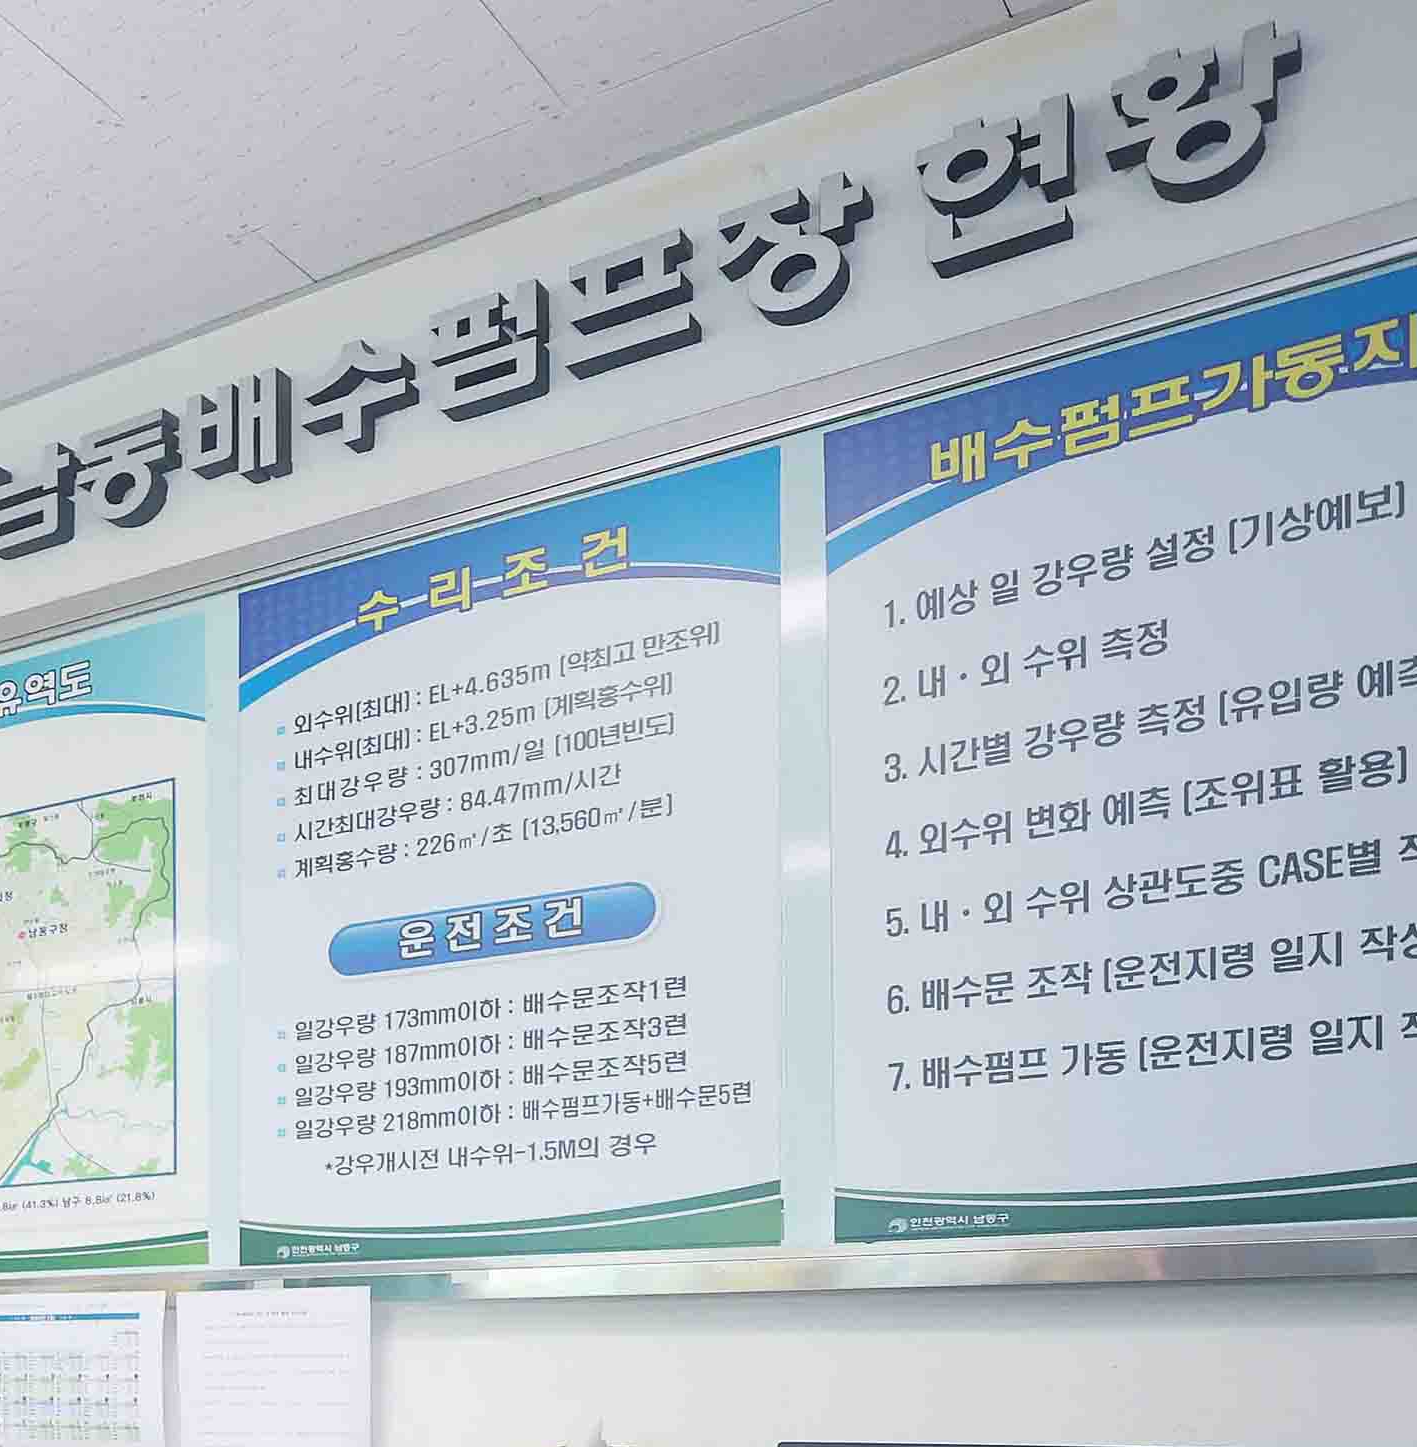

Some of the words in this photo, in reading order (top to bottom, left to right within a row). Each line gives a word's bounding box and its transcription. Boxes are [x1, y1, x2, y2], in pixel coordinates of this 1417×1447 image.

[915, 20, 1303, 278] 현황
[883, 598, 907, 629] 1.
[915, 579, 979, 622] 예상
[989, 569, 1020, 606] 일
[1032, 543, 1134, 598] 강우량
[1146, 523, 1216, 572] 설정
[428, 660, 551, 706] EL+4.635m
[882, 674, 907, 707] 2.
[1022, 634, 1088, 679] 수위
[1100, 617, 1170, 659] 측정
[428, 701, 537, 743] EL+3.25m
[883, 751, 909, 784] 3.
[917, 730, 1013, 779] 시간별
[1025, 709, 1126, 759] 강우량
[1137, 693, 1207, 738] 측정
[292, 765, 410, 807] 최대강우량
[428, 738, 546, 781] 307mm/일
[292, 796, 442, 845] 시간최대강우량
[458, 762, 623, 813] 84.47mm/시간
[884, 830, 909, 859] 4.
[919, 810, 1013, 858] 외수위
[1026, 798, 1092, 841] 변화
[1102, 786, 1171, 828] 예측
[292, 842, 399, 880] 계획홍수량
[885, 907, 910, 938] 5.
[1026, 879, 1092, 920] 수위
[1103, 858, 1245, 912] 상관도중
[1257, 836, 1382, 889] CASE별
[396, 895, 585, 962] 운전조건
[886, 984, 910, 1016] 6.
[921, 970, 1015, 1013] 배수문
[1026, 959, 1093, 1000] 조작
[1269, 930, 1344, 973] 일지
[293, 1013, 378, 1043] 일강우량
[382, 997, 502, 1033] 173mm이하
[522, 974, 689, 1017] 배수문조작1련
[293, 1047, 378, 1076] 일강우량
[382, 1032, 502, 1067] 187mm이하
[522, 1011, 689, 1053] 배수문조작3련
[293, 1081, 378, 1109] 일강우량
[382, 1067, 502, 1101] 193mm이하
[522, 1047, 689, 1088] 배수문조작5련
[887, 1059, 911, 1092] 7.
[921, 1046, 1049, 1091] 배수펌프
[1060, 1038, 1127, 1079] 가동
[1308, 1013, 1385, 1057] 일지
[293, 1113, 378, 1141] 일강우량
[382, 1102, 502, 1134] 218mm이하
[520, 1079, 754, 1124] 배수펌프가동+배수문5련
[446, 1134, 601, 1170] 내수위-1.5M의
[607, 1131, 659, 1160] 경우
[61, 1194, 82, 1210] 남구
[909, 1215, 969, 1229] 인천광역시
[972, 1212, 1010, 1226] 남동구
